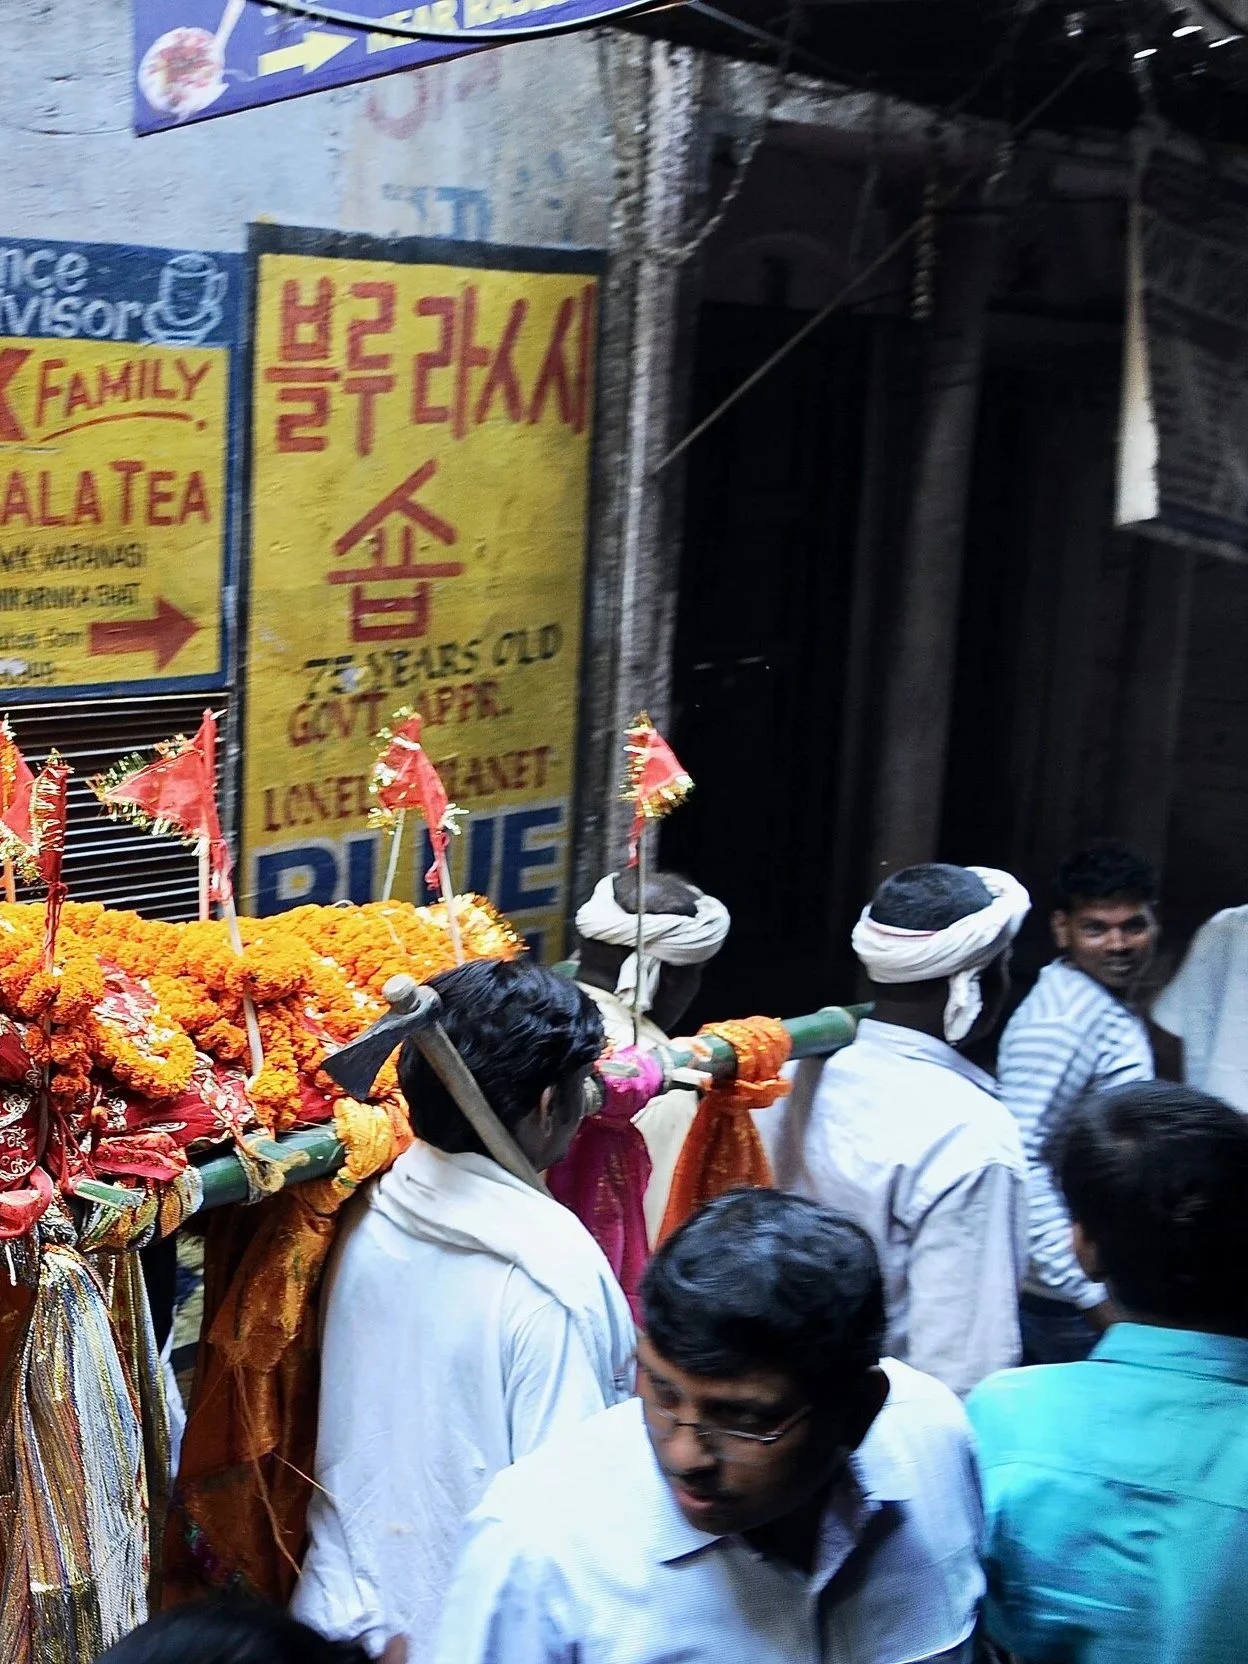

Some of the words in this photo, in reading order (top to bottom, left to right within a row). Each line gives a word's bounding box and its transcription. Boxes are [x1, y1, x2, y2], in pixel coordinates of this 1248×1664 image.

[107, 459, 211, 526] TEA
[326, 458, 466, 643] 숍
[364, 637, 482, 690] YEARS
[491, 621, 564, 668] OLD
